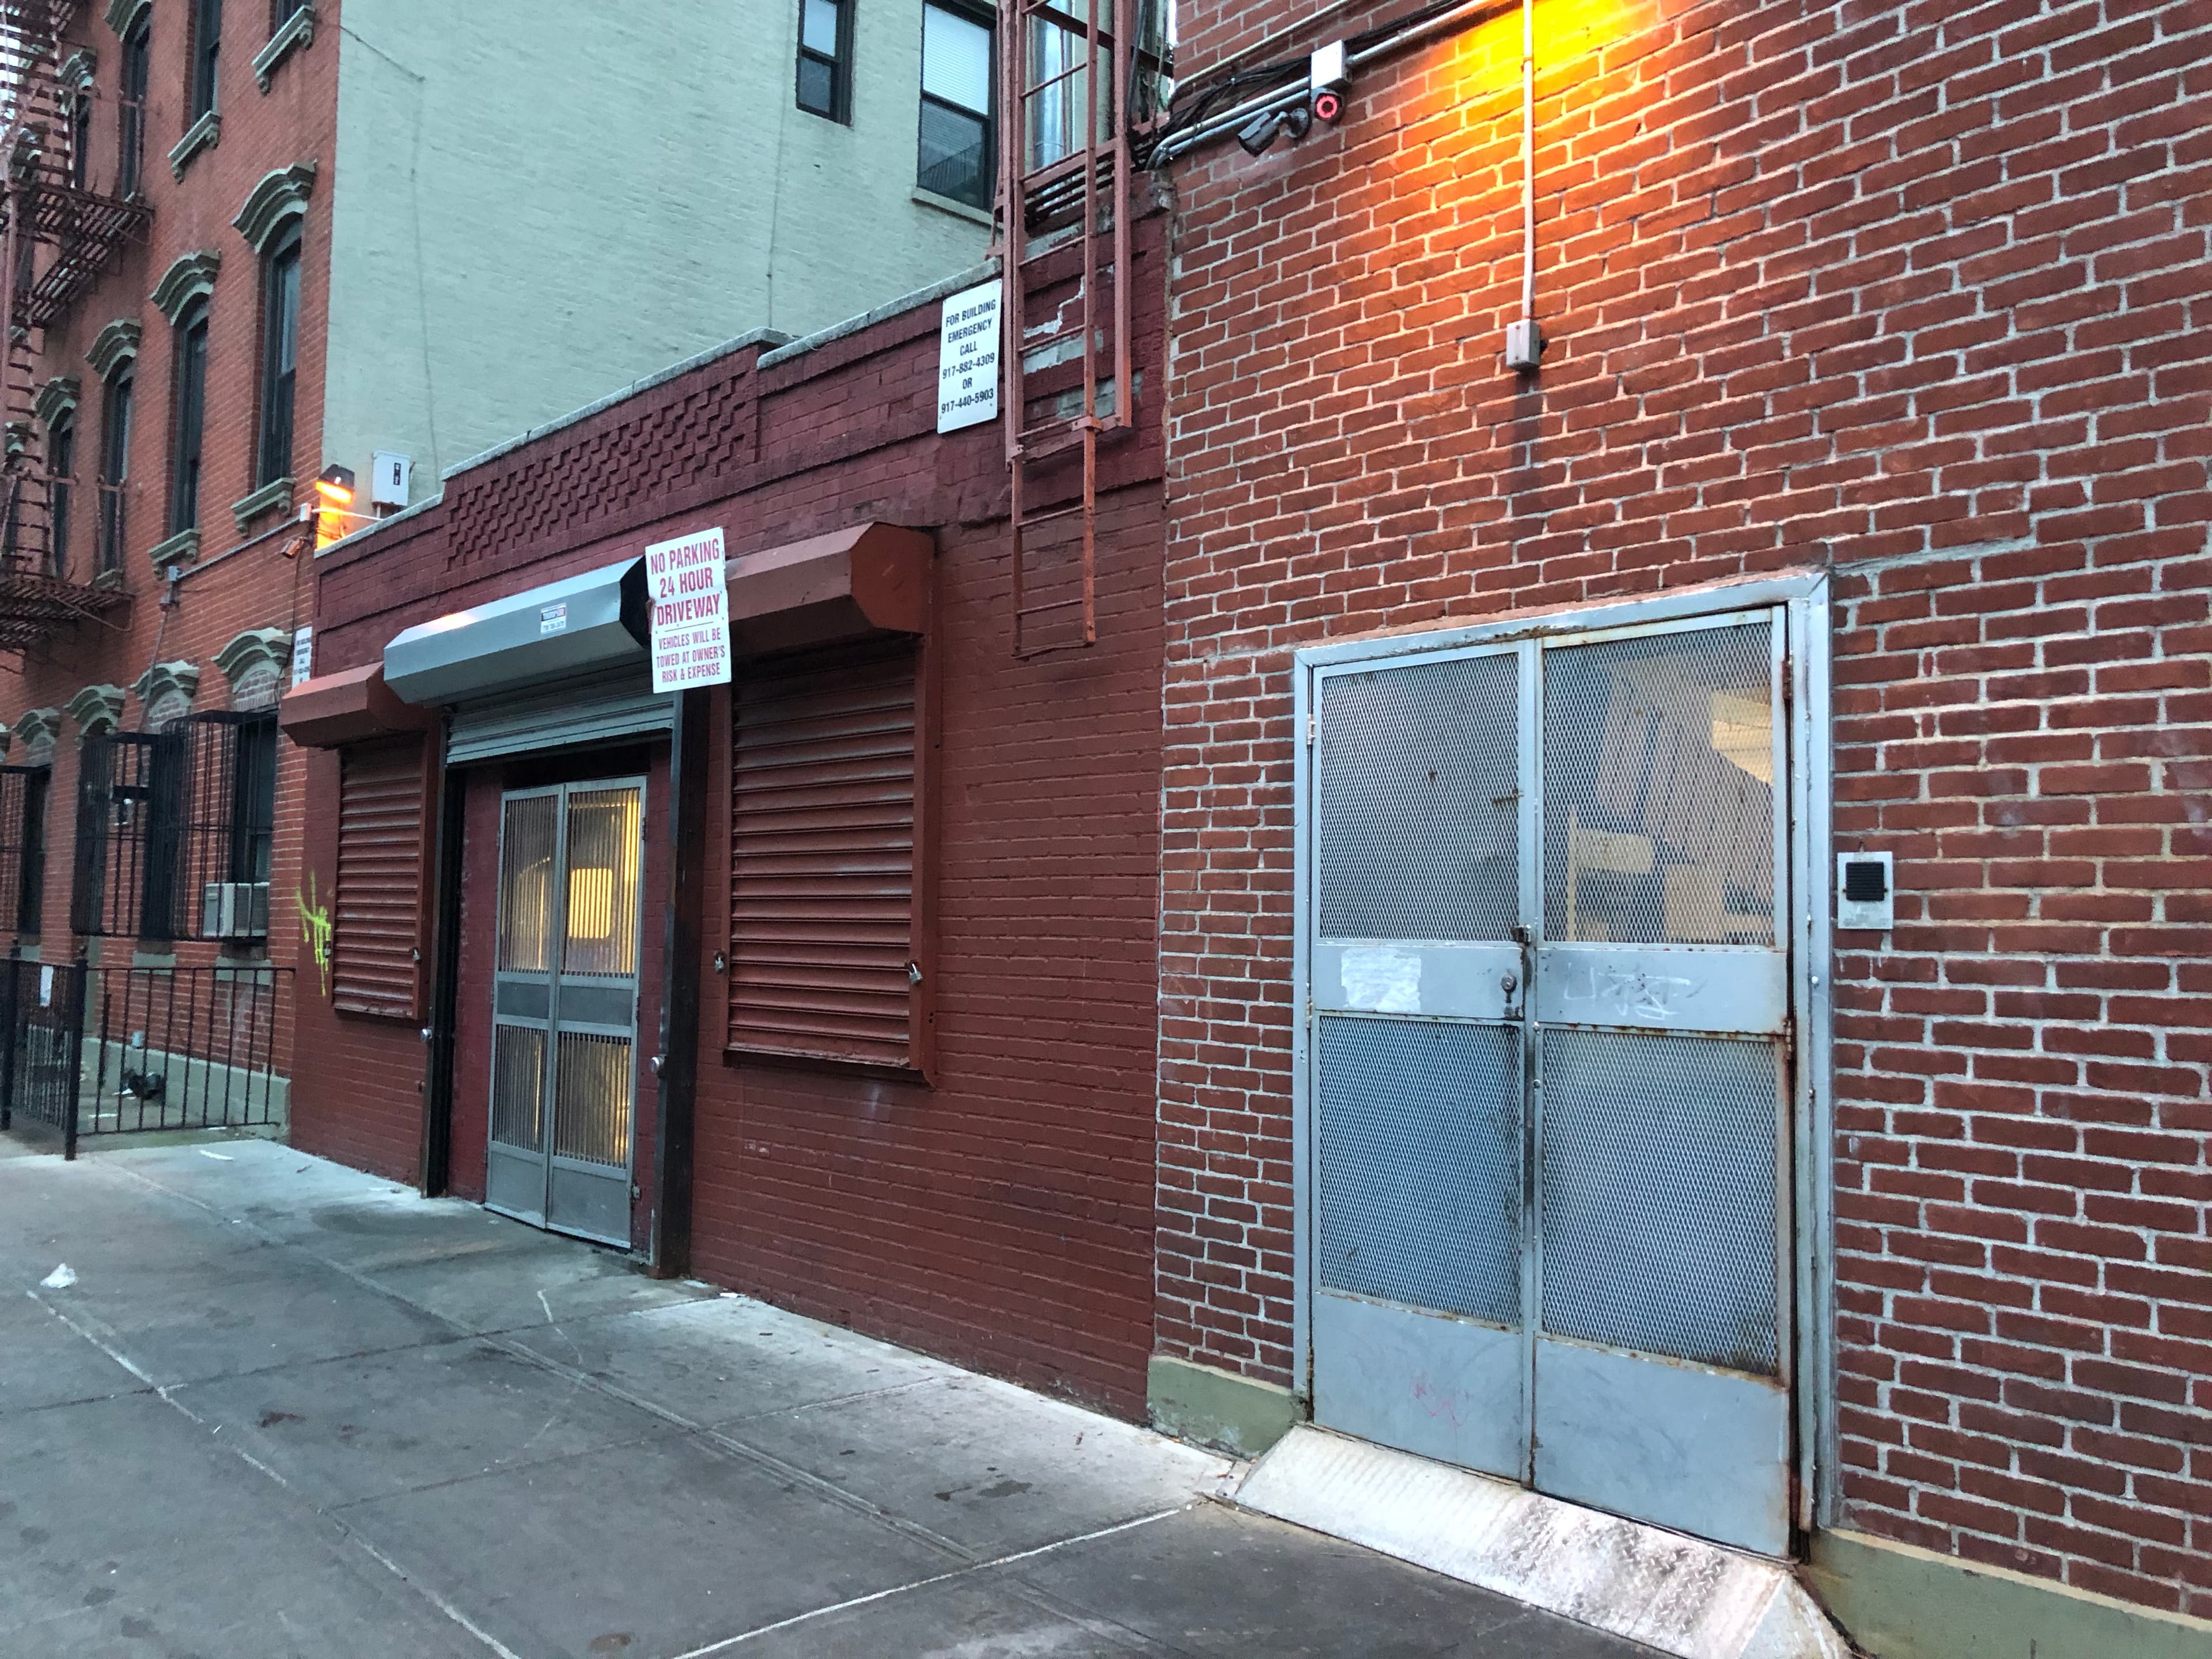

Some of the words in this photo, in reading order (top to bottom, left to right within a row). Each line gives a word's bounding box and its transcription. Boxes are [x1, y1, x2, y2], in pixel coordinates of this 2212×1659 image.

[946, 313, 960, 327] FOR
[962, 299, 996, 321] BUILDING
[948, 317, 993, 343] EMERGENCY
[960, 341, 978, 356] CALL
[963, 377, 972, 389] OR
[941, 388, 994, 414] 917-440-5903
[650, 552, 665, 575] NO
[669, 537, 719, 570] PARKING
[660, 576, 675, 599] 24
[679, 566, 713, 594] HOUR
[657, 593, 720, 626] DRIVEWAY
[658, 633, 690, 650] VEHICLES
[692, 629, 709, 644] WILL
[711, 627, 721, 641] BE
[657, 653, 679, 668] TOWED
[682, 651, 690, 664] AT
[692, 645, 725, 662] OWNER'S
[662, 669, 677, 683] RISK
[680, 668, 685, 680] &
[688, 662, 720, 679] EXPENSE
